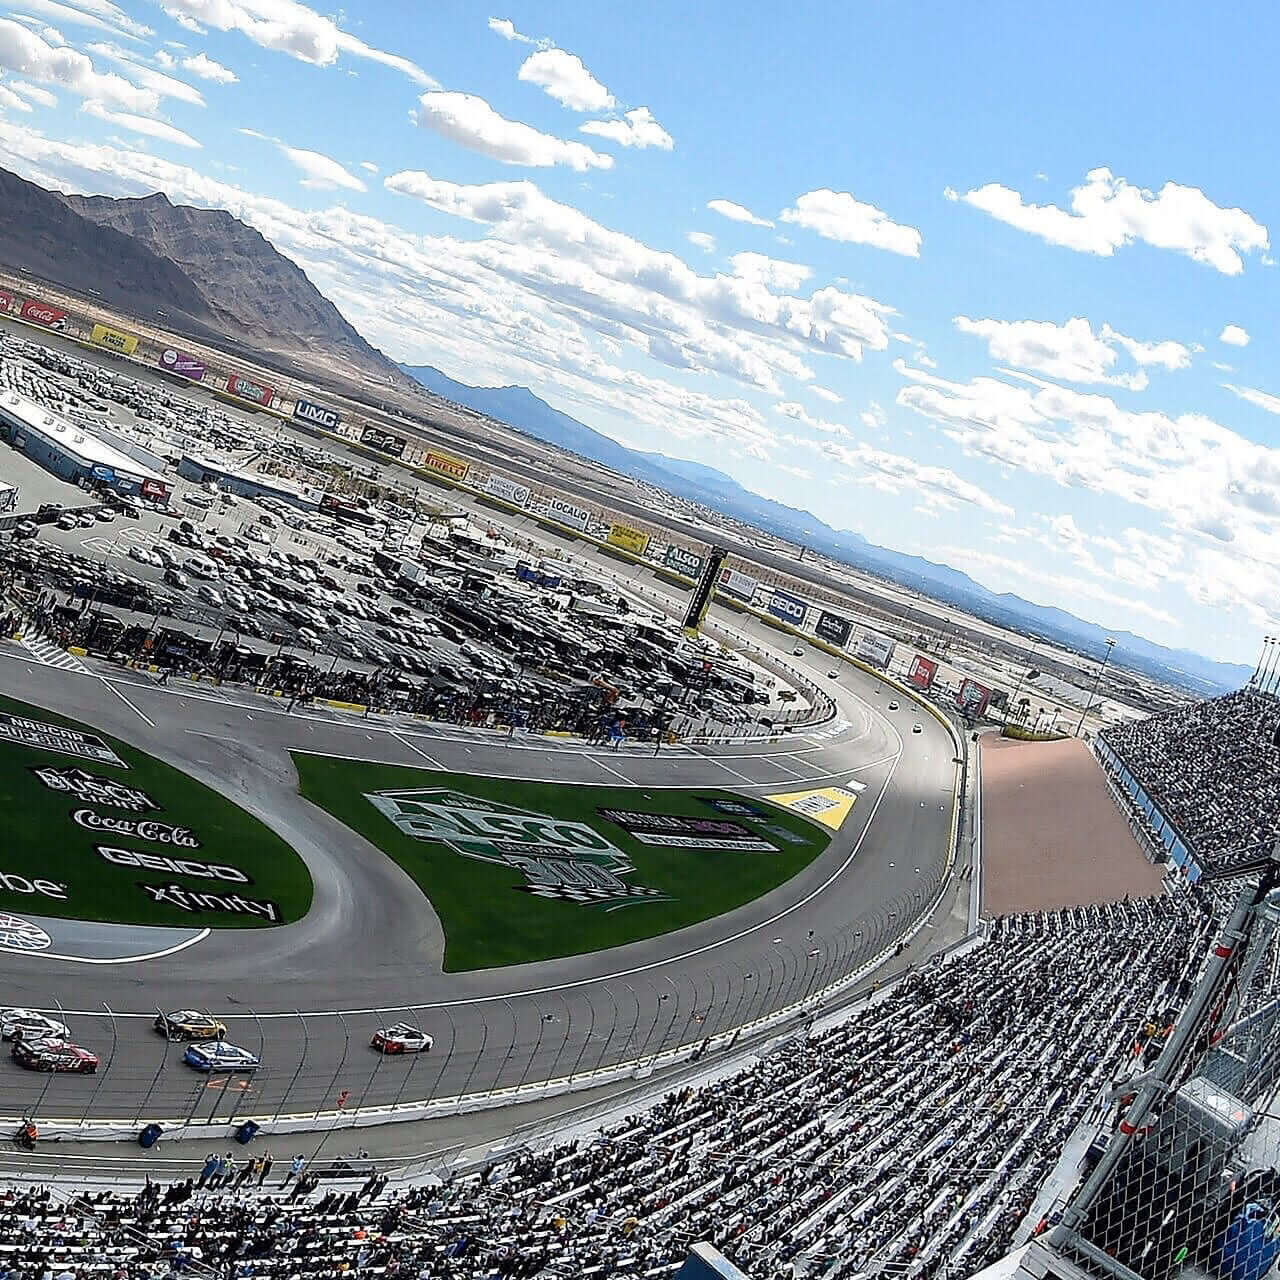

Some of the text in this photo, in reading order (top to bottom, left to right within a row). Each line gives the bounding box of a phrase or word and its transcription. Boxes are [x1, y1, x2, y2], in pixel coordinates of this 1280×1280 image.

[669, 547, 700, 568] ALSCO
[771, 595, 804, 619] GEICO
[10, 717, 84, 742] NASCAR
[39, 771, 161, 811] BUSCH
[96, 845, 250, 883] GEICO
[143, 884, 277, 922] xfinity
